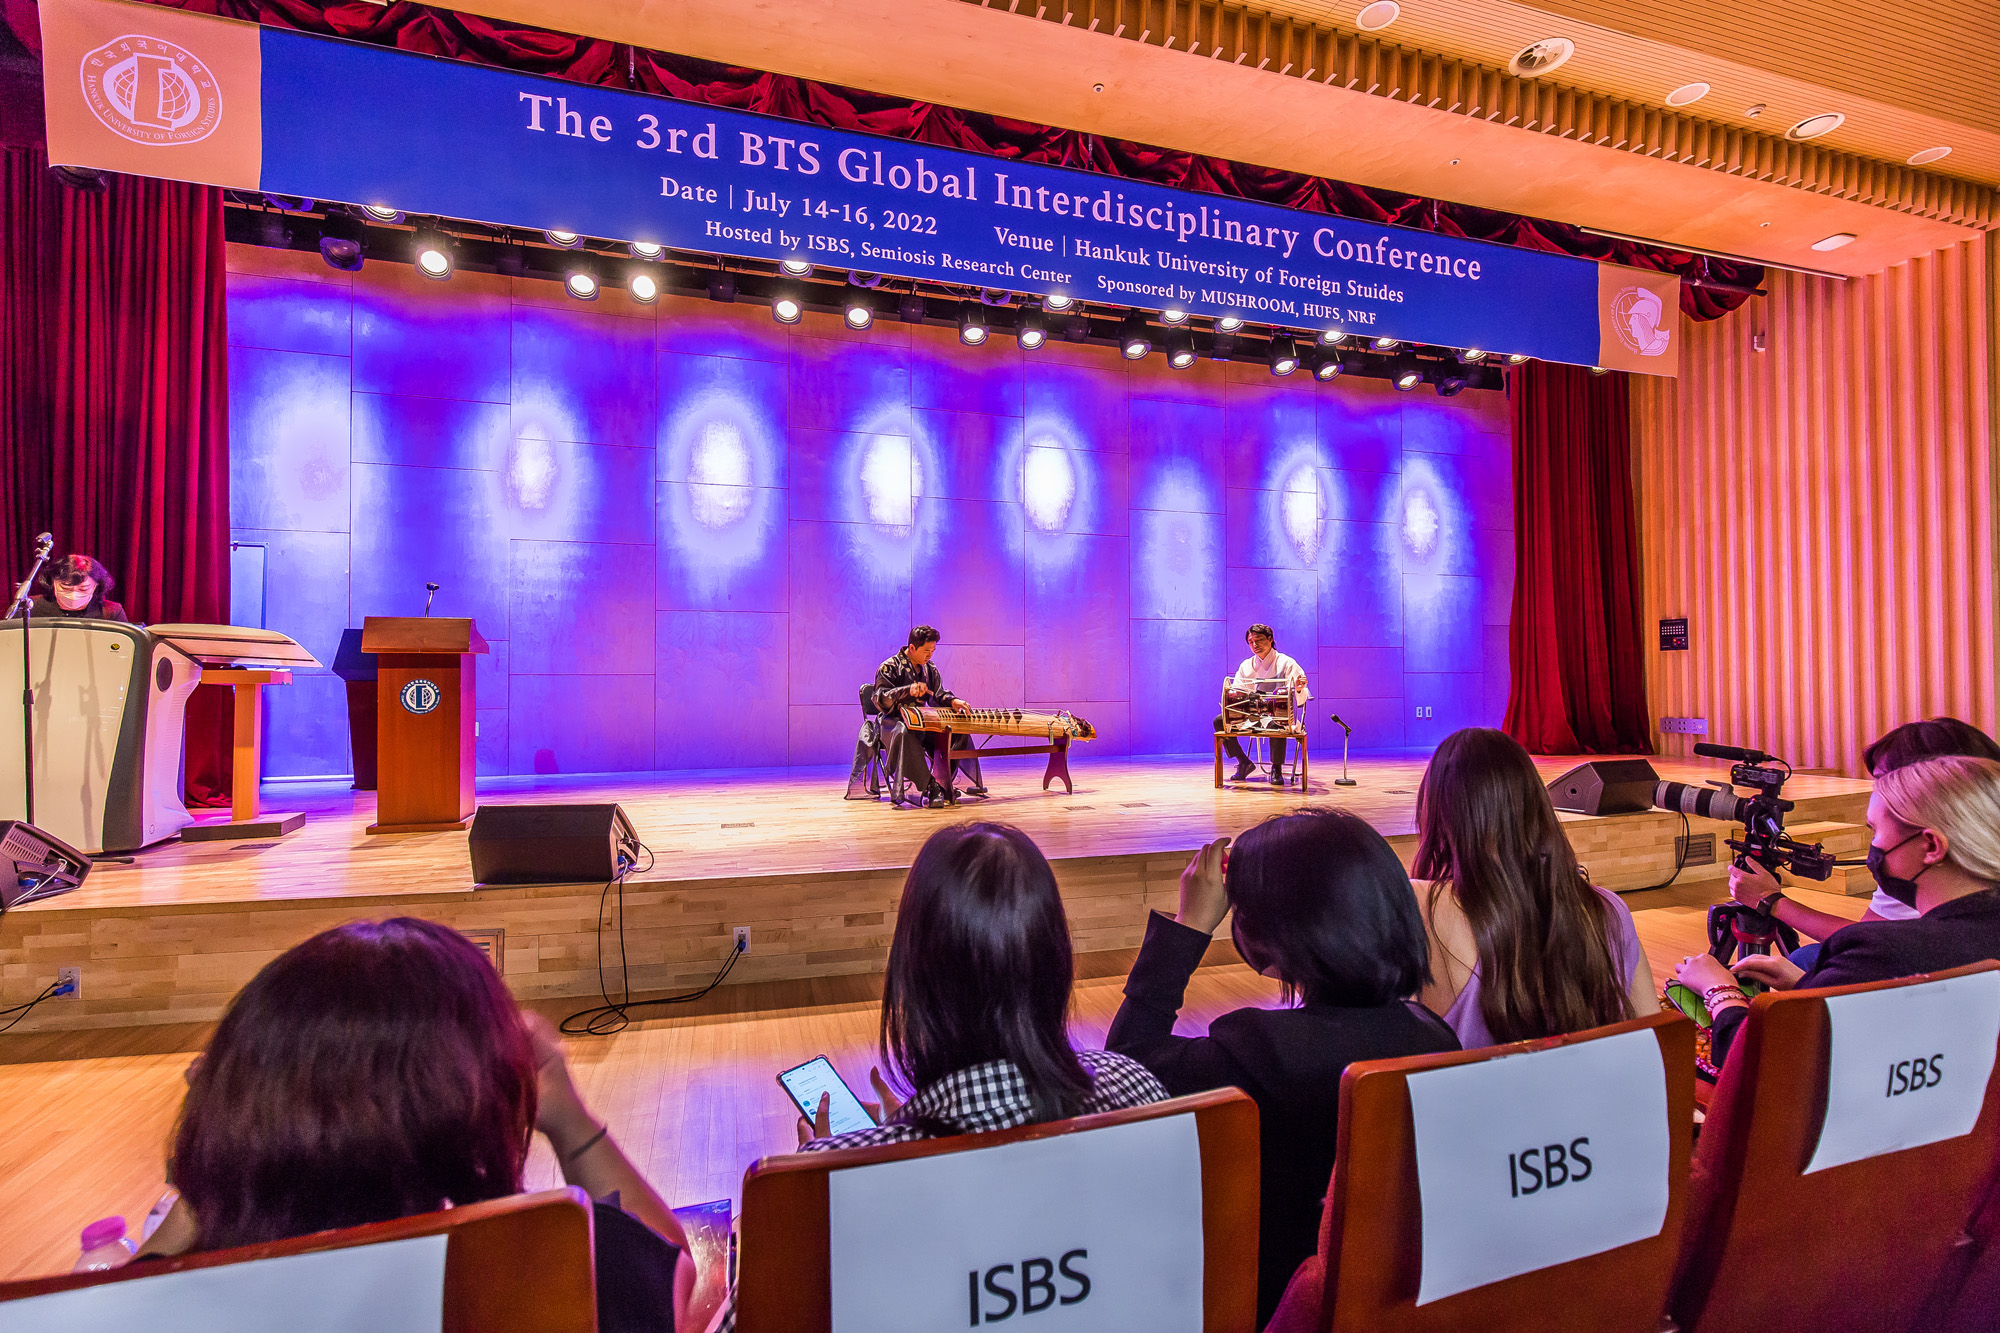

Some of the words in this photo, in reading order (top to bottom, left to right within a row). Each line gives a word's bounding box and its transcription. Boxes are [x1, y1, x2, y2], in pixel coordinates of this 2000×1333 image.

[91, 40, 212, 89] 한국외국어대학교
[520, 92, 612, 141] The
[637, 114, 718, 159] 3rd
[740, 132, 819, 174] BTS
[838, 148, 977, 200] Global
[994, 173, 1299, 258] Interdisciplinary
[1314, 228, 1480, 280] Conference
[660, 177, 717, 203] Date
[743, 190, 791, 217] July
[803, 198, 875, 230] 14-16,
[884, 210, 937, 234] 2022
[706, 220, 772, 244] Hosted
[780, 230, 801, 251] by
[808, 235, 857, 258] ISBS,
[861, 242, 935, 265] Semiosis
[942, 253, 1014, 276] Research
[1021, 265, 1071, 283] Center
[994, 227, 1053, 251] Venue
[1075, 239, 1150, 266] Hankuk
[1157, 251, 1248, 283] University
[1255, 267, 1273, 283] of
[1279, 269, 1341, 296] Foreign
[1347, 280, 1403, 302] Stuides
[1098, 276, 1174, 297] Sponsored
[1180, 286, 1196, 303] by
[1201, 289, 1299, 317] MUSHROOM,
[1304, 303, 1344, 323] HUFS,
[1347, 310, 1376, 324] NRF
[1886, 1053, 1944, 1098] ISBS
[1508, 1136, 1593, 1199] ISBS
[968, 1248, 1092, 1328] ISBS
